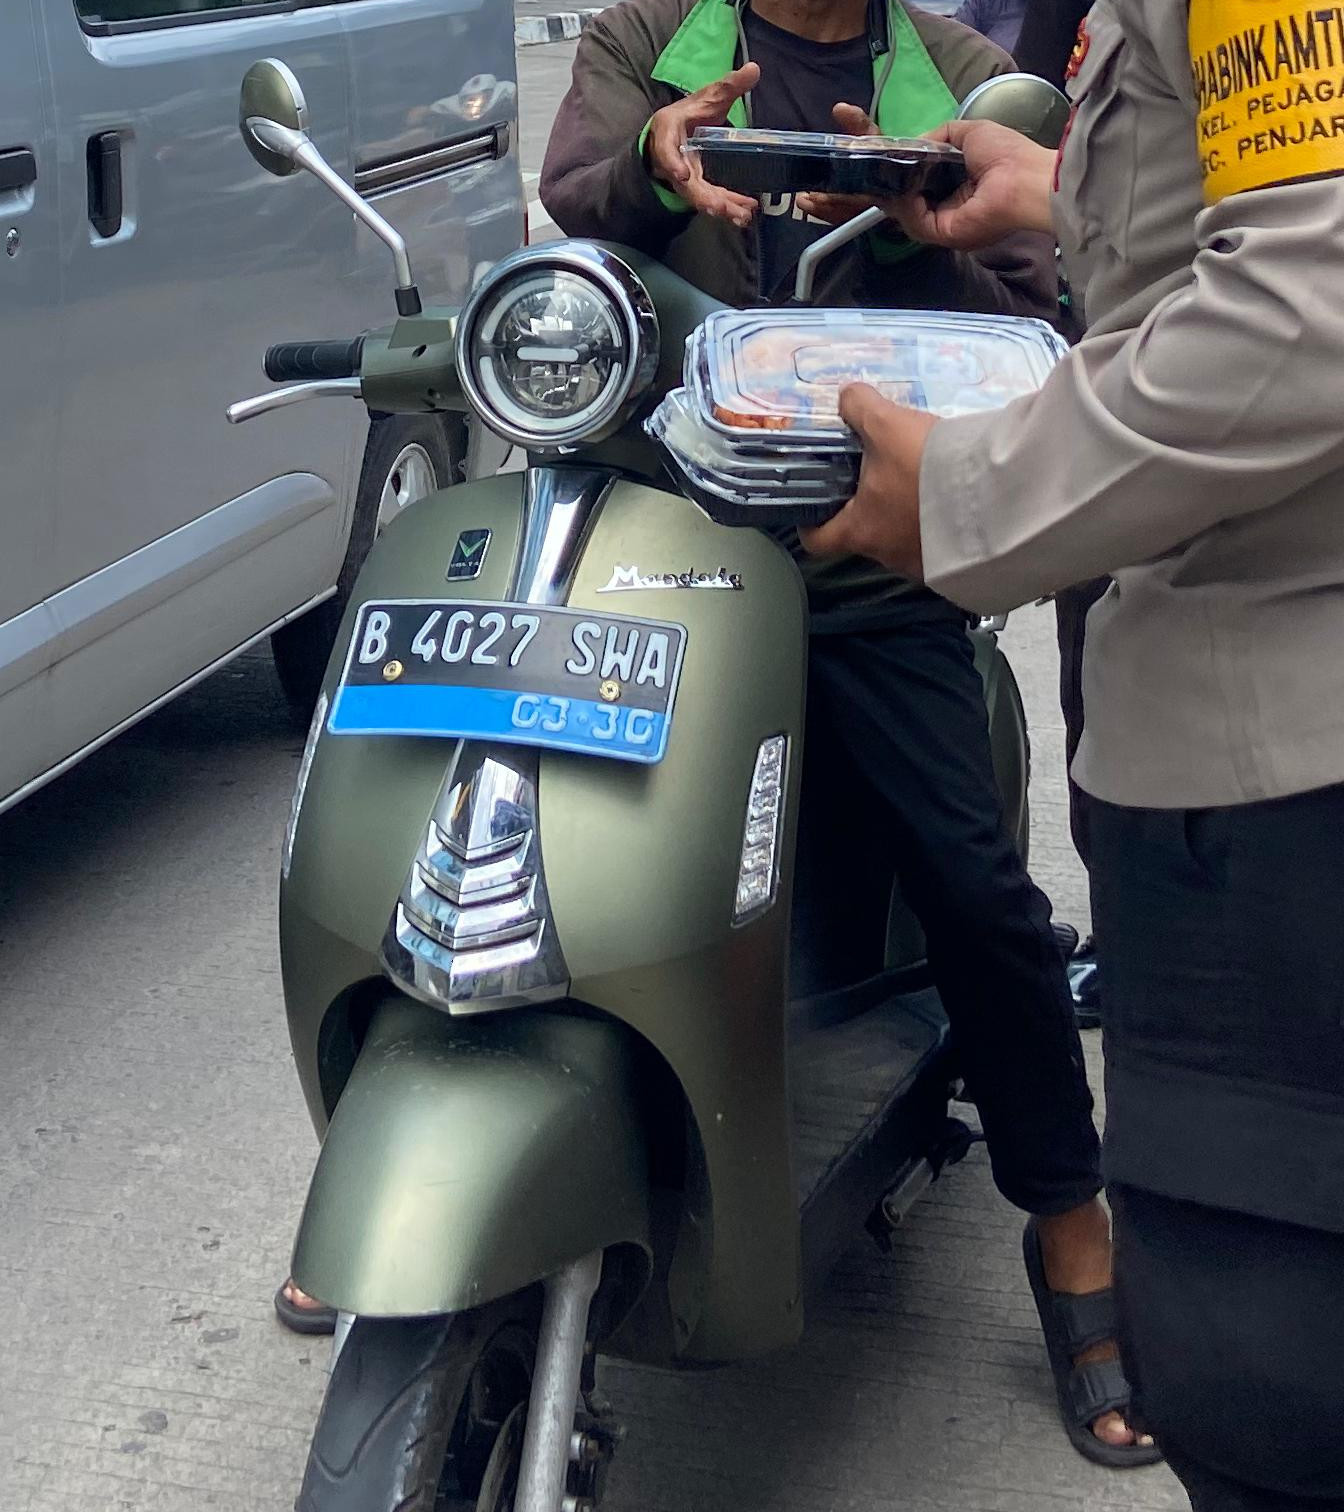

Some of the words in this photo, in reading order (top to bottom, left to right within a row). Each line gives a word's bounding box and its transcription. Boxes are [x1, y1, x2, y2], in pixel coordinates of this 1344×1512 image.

[358, 610, 392, 665] B
[411, 609, 542, 668] 4027
[565, 620, 670, 689] SWA
